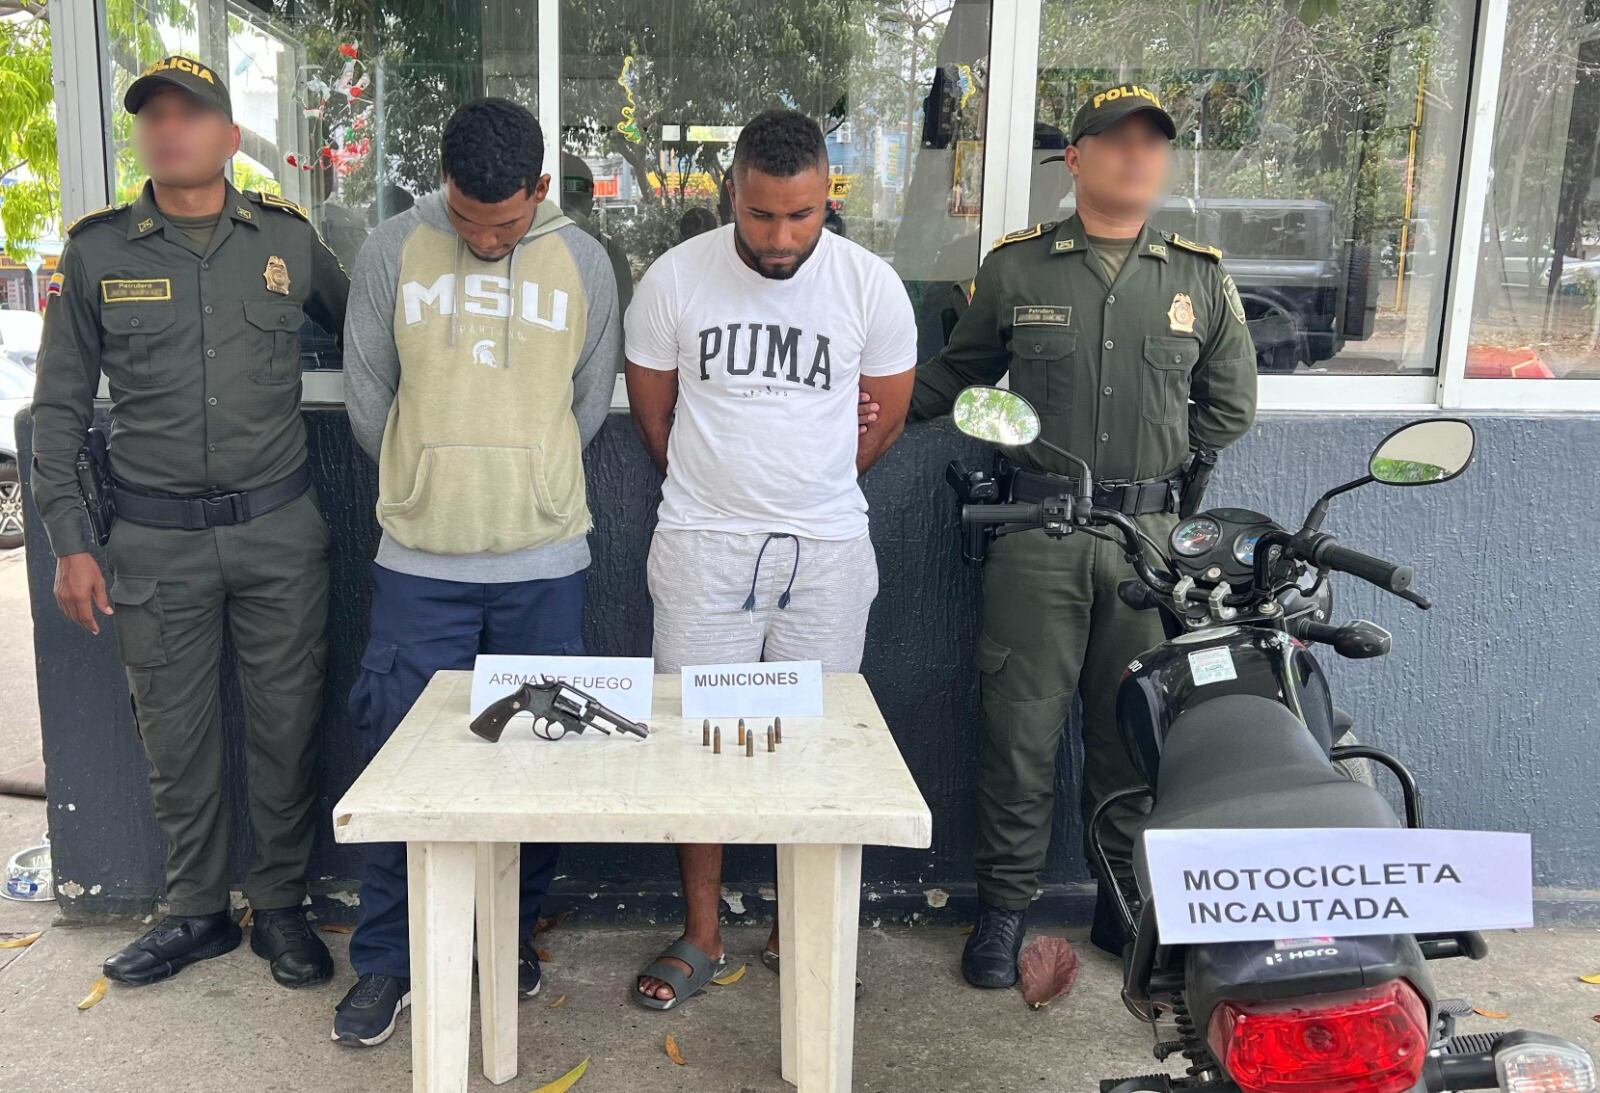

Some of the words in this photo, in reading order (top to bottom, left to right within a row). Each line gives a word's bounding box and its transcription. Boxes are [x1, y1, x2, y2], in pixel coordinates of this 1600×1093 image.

[402, 271, 569, 332] MSU
[698, 323, 832, 391] PUMA
[489, 673, 538, 685] ARMA
[573, 676, 633, 691] FUEGO
[694, 671, 799, 688] MUNICIONES
[1183, 863, 1462, 892] MOTOCICLETA
[1188, 896, 1409, 924] INCAUTADA
